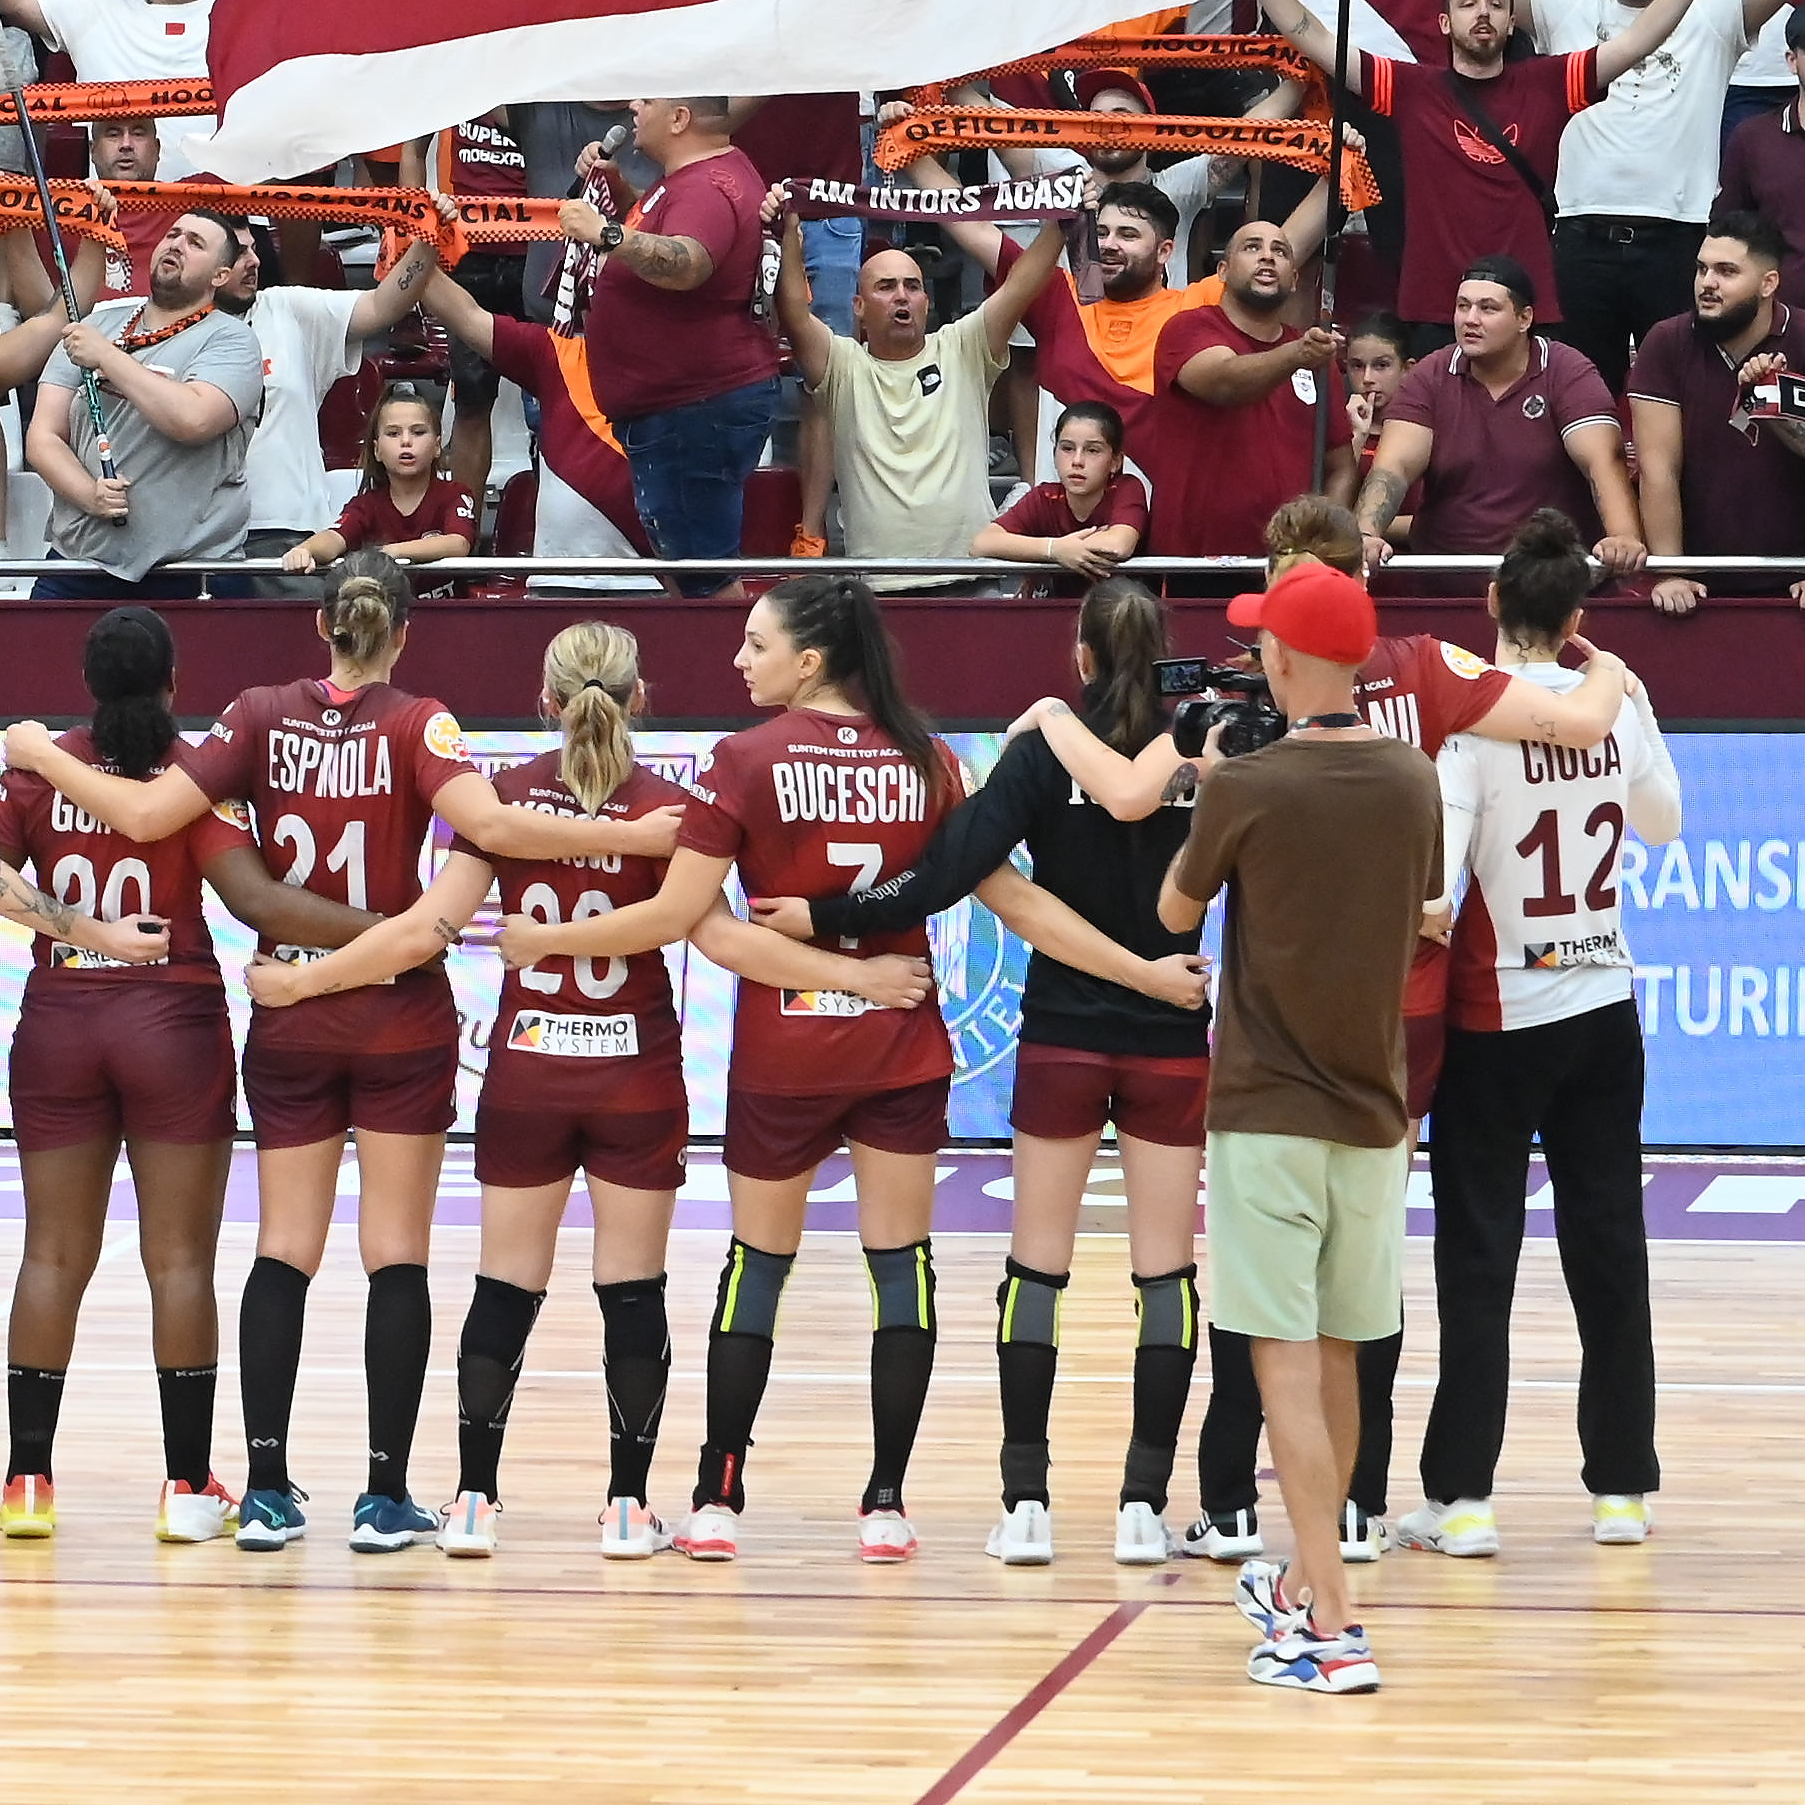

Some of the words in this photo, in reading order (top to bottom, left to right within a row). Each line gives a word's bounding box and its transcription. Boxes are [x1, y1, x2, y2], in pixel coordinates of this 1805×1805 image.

[905, 116, 1061, 143] OFFICIAL
[1155, 121, 1337, 160] HOOLIGAN
[458, 148, 526, 169] MOBEXP
[809, 177, 856, 207] AM
[460, 202, 532, 224] CIAL
[788, 743, 827, 757] SUNTEM
[772, 760, 927, 824] BUCESCHI
[272, 812, 368, 914] 21
[1515, 801, 1624, 919] 12
[1623, 840, 1805, 912] RANS
[546, 1019, 629, 1038] THERMO
[541, 1035, 631, 1055] SYSTEM
